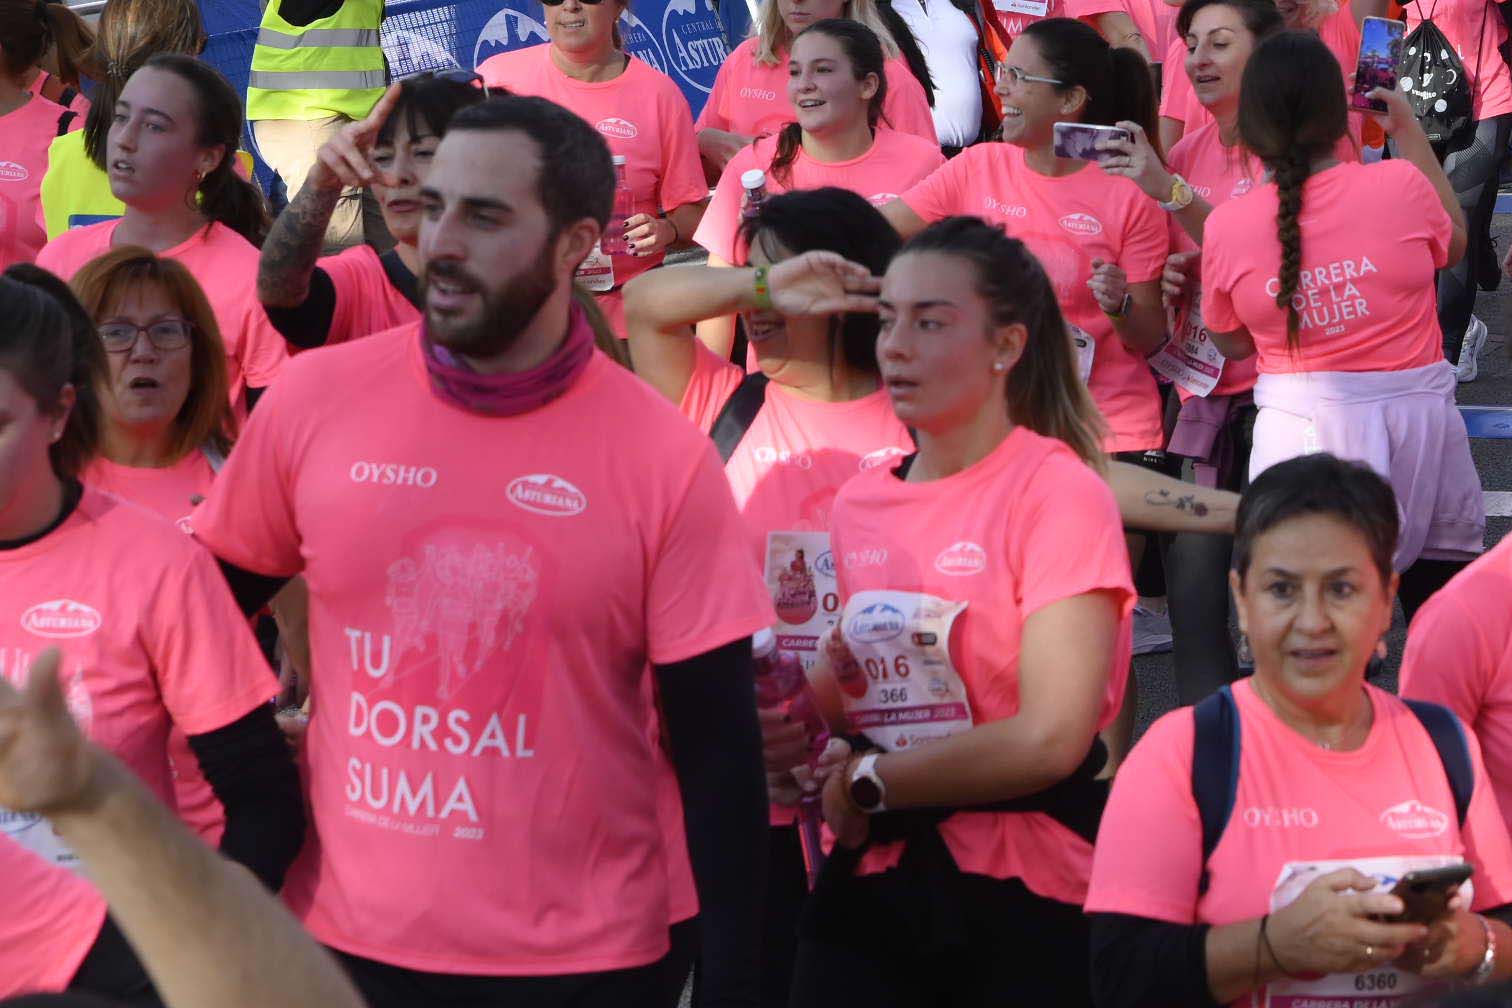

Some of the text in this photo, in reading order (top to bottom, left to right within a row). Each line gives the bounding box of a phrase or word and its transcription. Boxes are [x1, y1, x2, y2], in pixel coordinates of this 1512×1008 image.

[740, 88, 776, 101] OYSHO
[1291, 282, 1362, 313] DE LA
[1297, 296, 1370, 328] MUJER
[1325, 324, 1346, 337] 2023
[350, 461, 438, 488] OYSHO
[345, 627, 392, 678] TU
[864, 654, 911, 681] 016
[348, 691, 536, 759] DORSAL
[345, 756, 479, 822] SUMA
[1354, 973, 1398, 991] 6360
